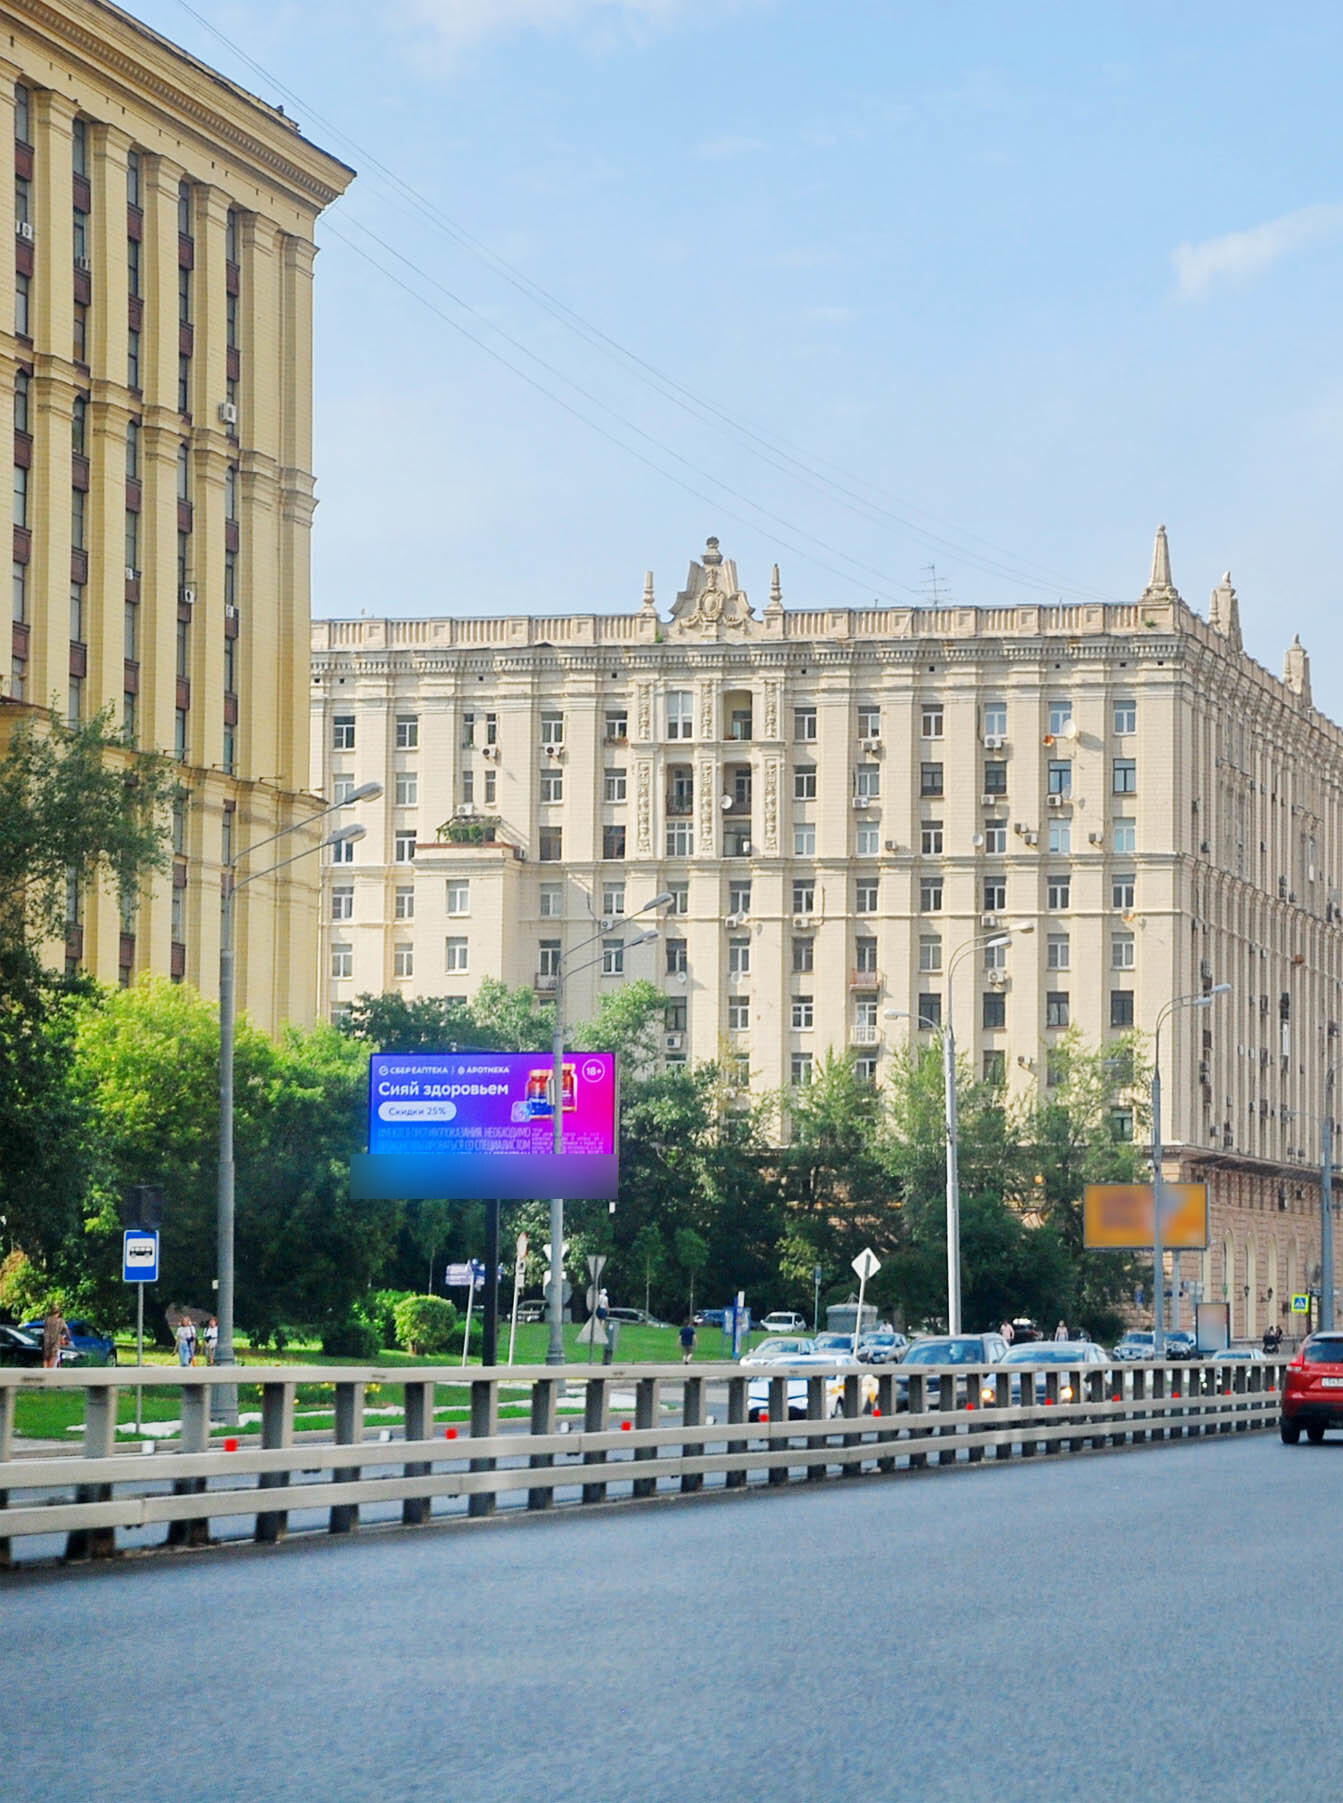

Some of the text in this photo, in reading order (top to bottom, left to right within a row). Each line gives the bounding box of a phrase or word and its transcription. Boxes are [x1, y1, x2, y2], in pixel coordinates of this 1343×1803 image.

[586, 1066, 602, 1076] 18+
[378, 1081, 509, 1098] Сияй здоровьем
[388, 1107, 446, 1117] Скидки 25%
